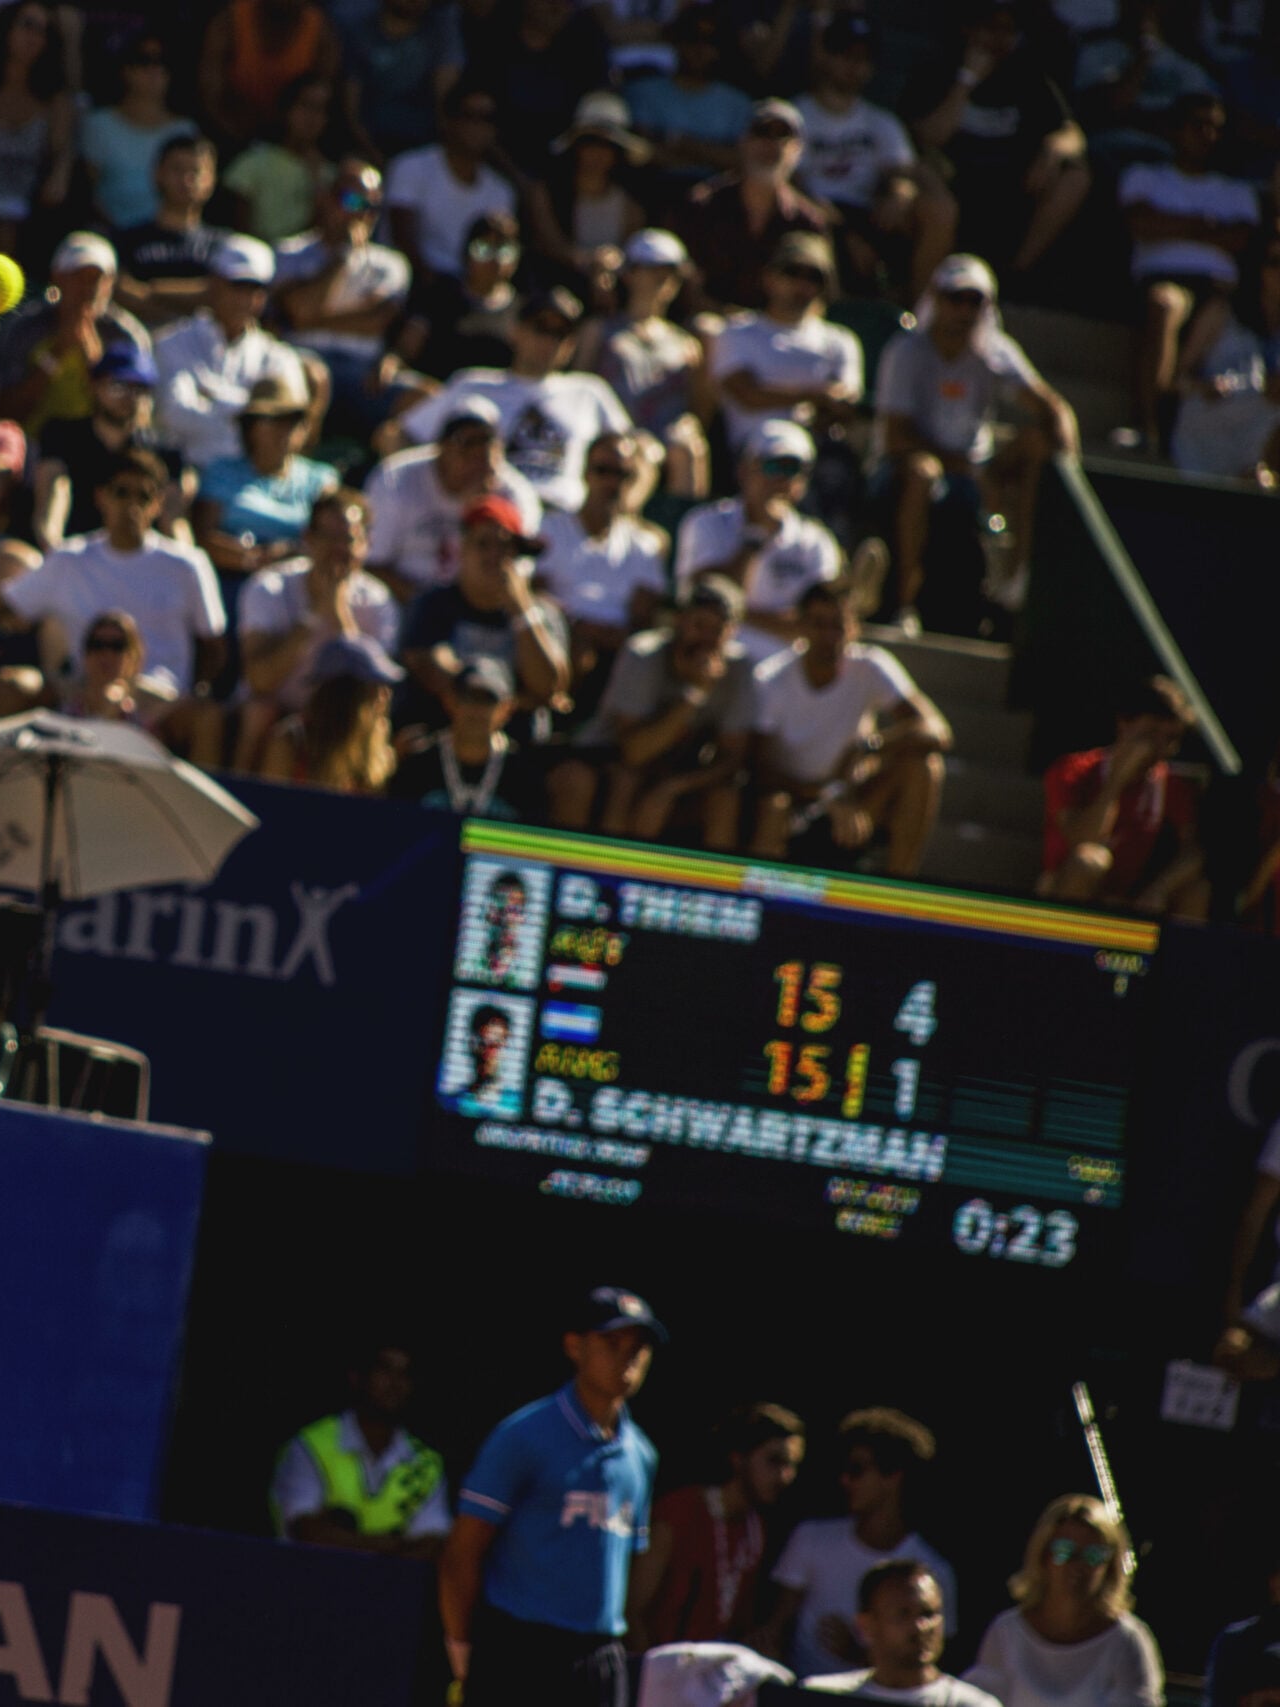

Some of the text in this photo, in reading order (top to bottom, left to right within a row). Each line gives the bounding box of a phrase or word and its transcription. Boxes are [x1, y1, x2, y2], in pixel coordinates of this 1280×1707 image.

[773, 961, 939, 1046] 15 4
[763, 1039, 921, 1122] 15 1
[589, 1086, 948, 1183] SCHWARTZMAN
[951, 1197, 1081, 1269] 0:23
